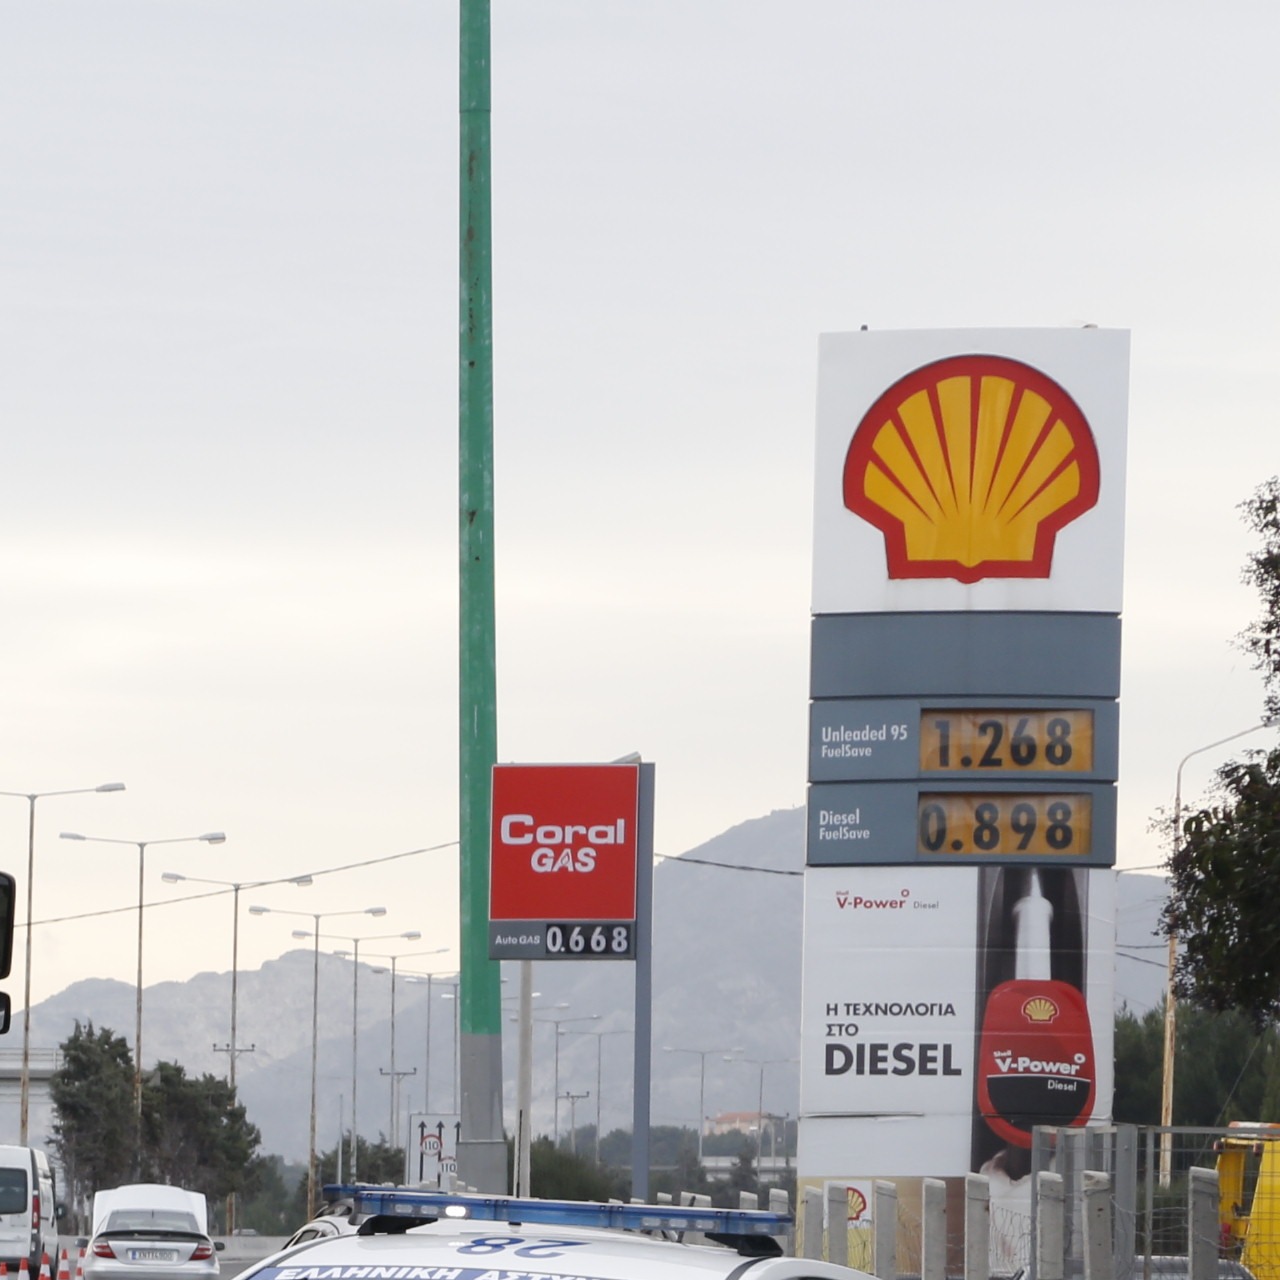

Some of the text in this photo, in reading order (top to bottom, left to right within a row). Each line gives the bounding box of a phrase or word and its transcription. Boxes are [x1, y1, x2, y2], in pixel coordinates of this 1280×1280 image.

[822, 718, 1072, 767] Unleaded 95 1.268
[822, 745, 872, 758] FuelSave
[500, 814, 625, 844] Coral
[820, 802, 1072, 850] Diesel 0.898
[820, 828, 870, 840] FuelSave
[530, 847, 597, 873] GAS
[836, 897, 939, 909] V-Power Diesel
[495, 926, 628, 953] Auto GAS 0.668
[826, 1003, 956, 1016] Η ΤΕΧΝΟΛΟΓΙΑ
[826, 1023, 859, 1036] ΣΤΟ
[825, 1042, 962, 1076] DIESEL
[995, 1057, 1080, 1075] V-Power
[1048, 1080, 1077, 1091] Diesel
[424, 1141, 439, 1150] 110
[441, 1164, 456, 1172] 110
[273, 1265, 462, 1280] ΕΛΛΗΝΙΚΗ
